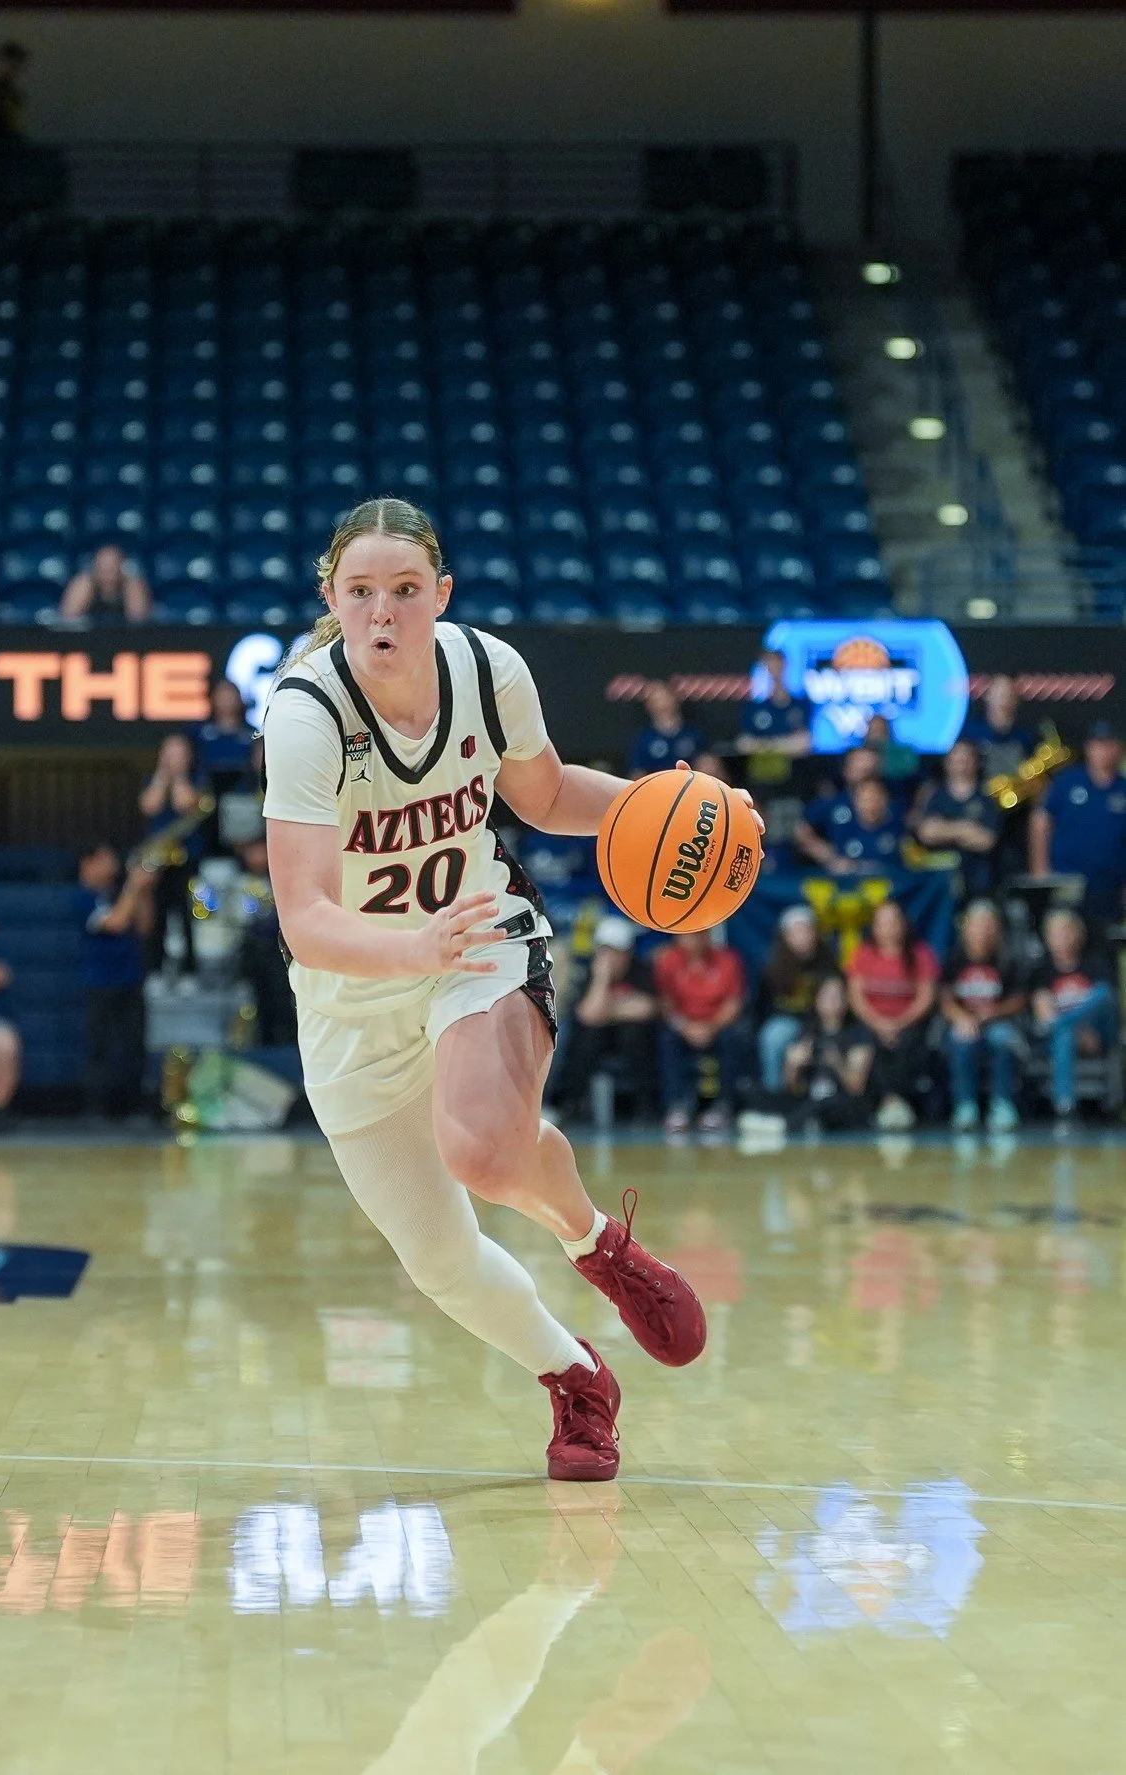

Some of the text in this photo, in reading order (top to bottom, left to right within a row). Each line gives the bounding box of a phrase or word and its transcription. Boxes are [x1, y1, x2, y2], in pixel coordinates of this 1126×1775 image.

[347, 741, 370, 751] WBIT
[343, 775, 488, 854] AZTECS
[662, 800, 719, 901] Wilson
[703, 839, 718, 874] EVO NXT
[731, 848, 750, 889] WBIT
[359, 847, 467, 914] 20
